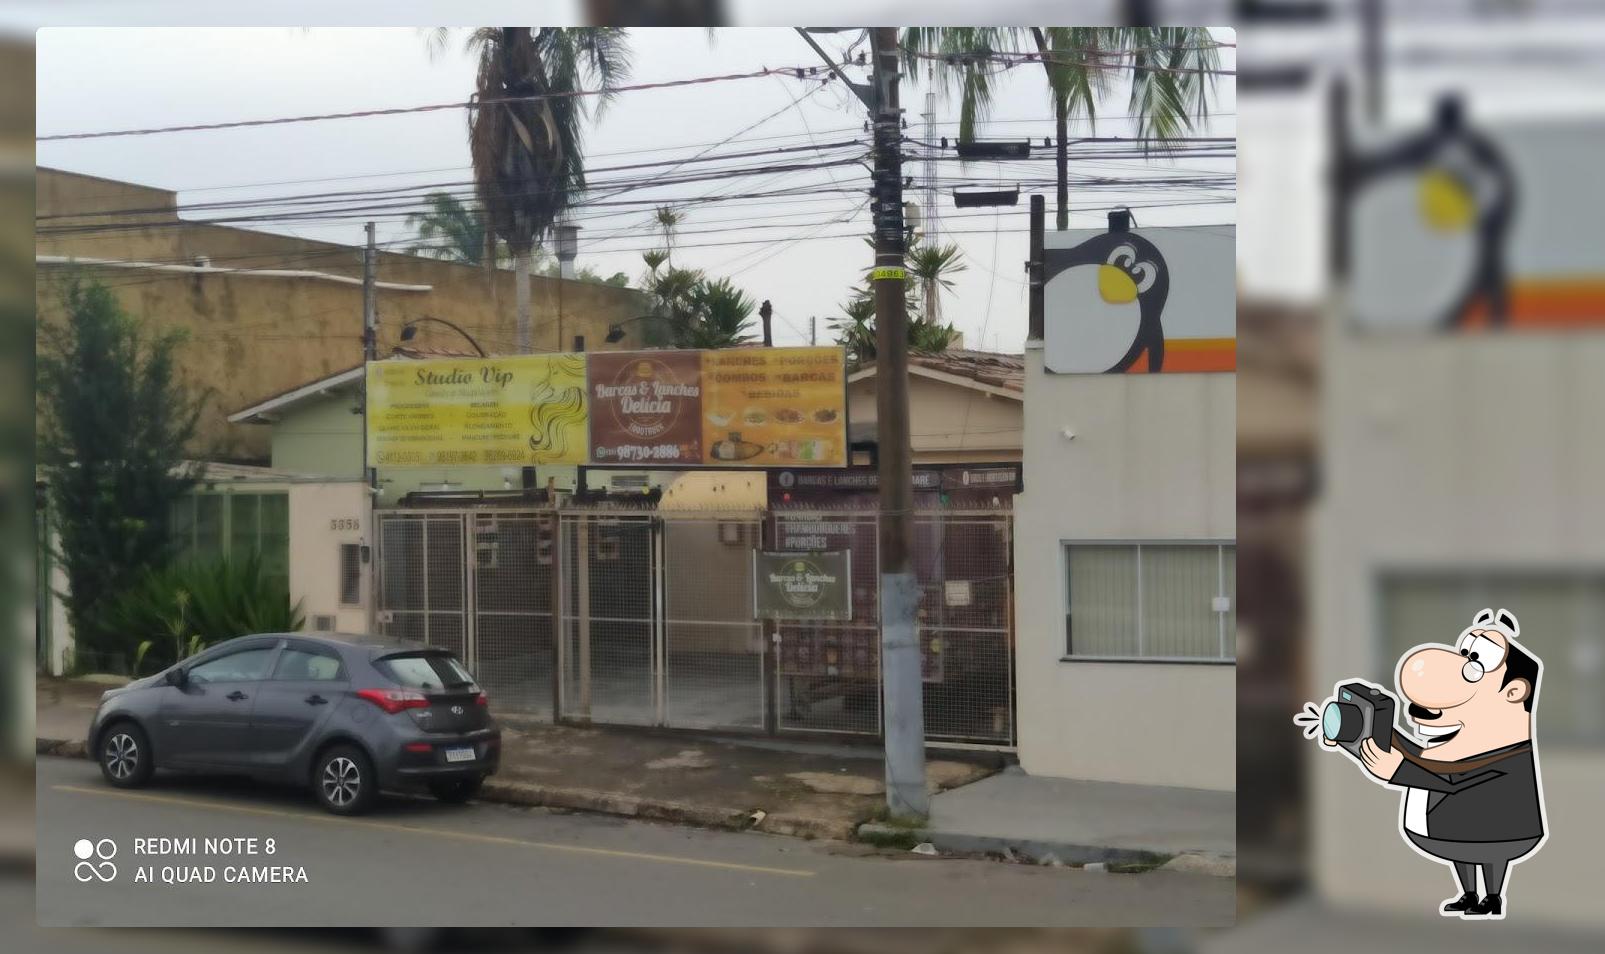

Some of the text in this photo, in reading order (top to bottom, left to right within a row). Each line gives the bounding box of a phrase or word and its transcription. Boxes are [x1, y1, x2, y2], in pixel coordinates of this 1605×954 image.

[414, 366, 514, 388] Studio Vip
[595, 381, 700, 400] Barcas & Lanches
[617, 444, 680, 460] 98730-2886
